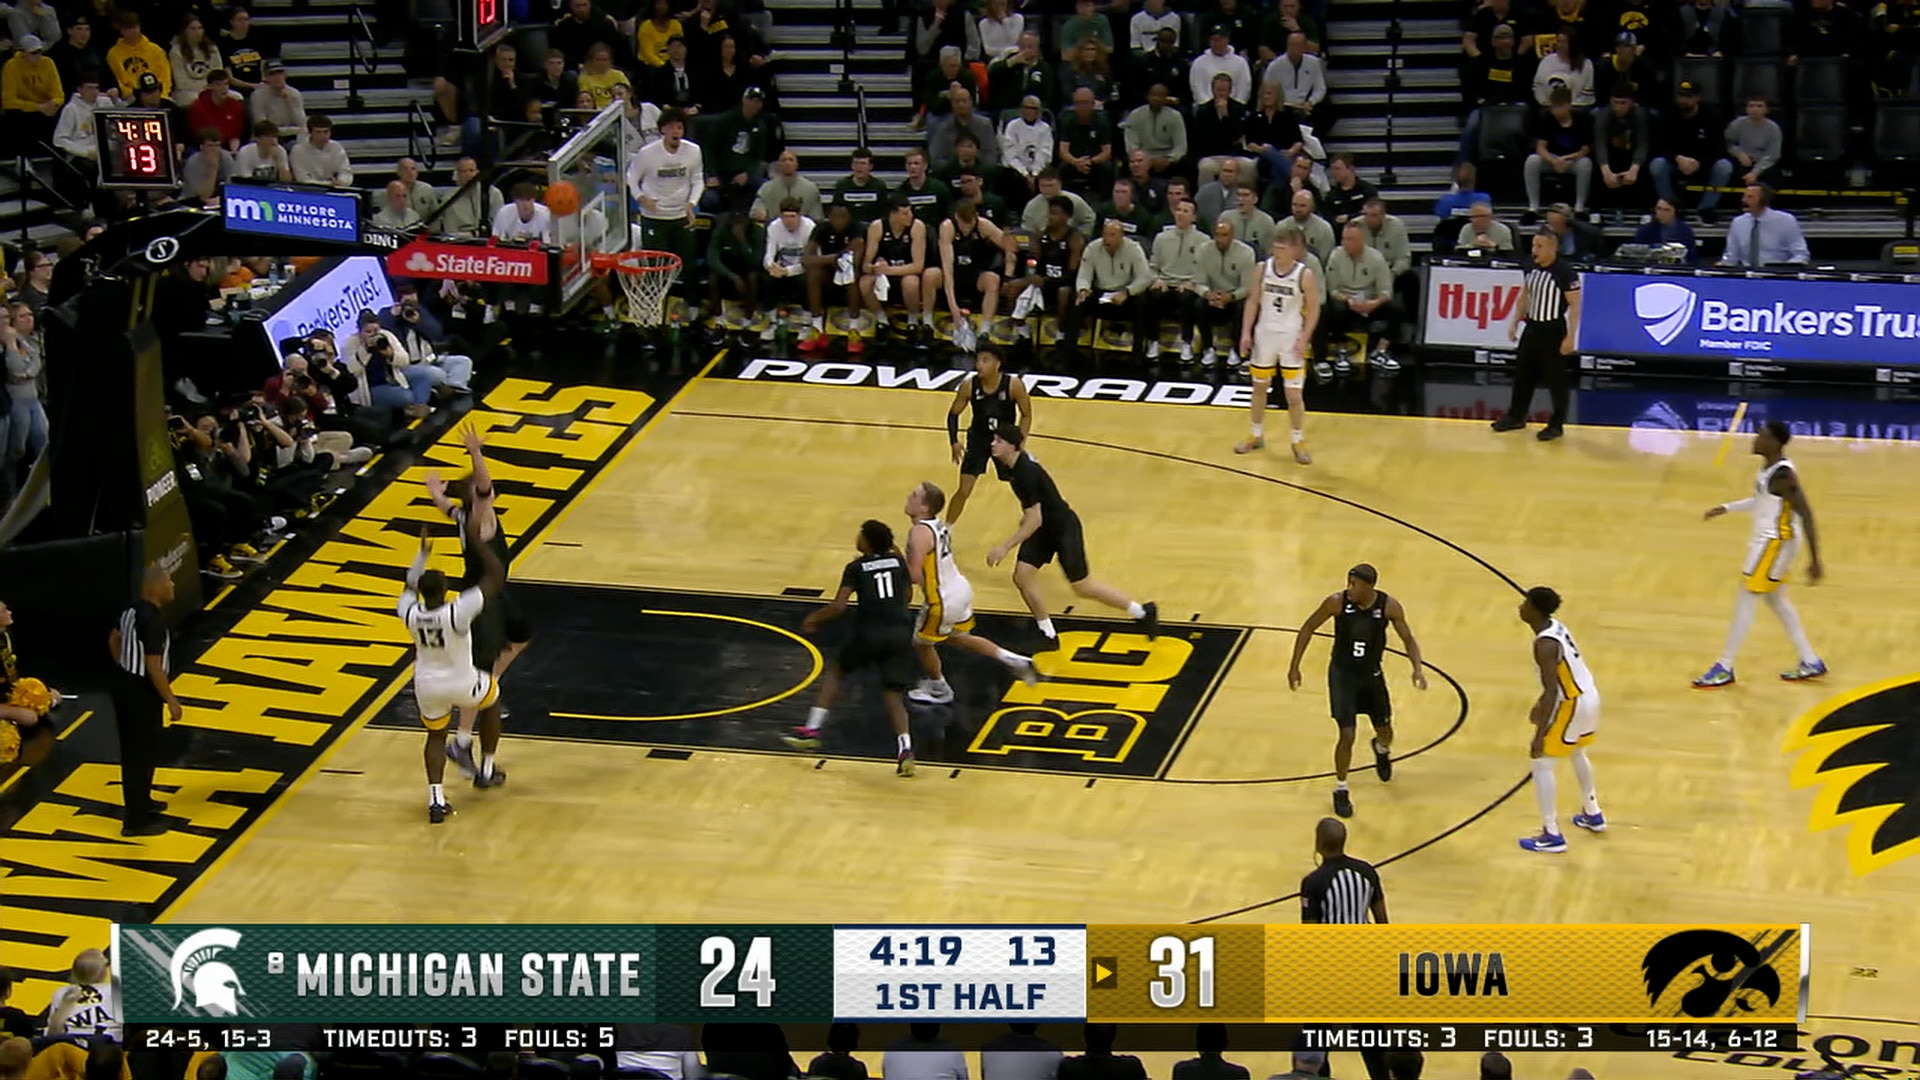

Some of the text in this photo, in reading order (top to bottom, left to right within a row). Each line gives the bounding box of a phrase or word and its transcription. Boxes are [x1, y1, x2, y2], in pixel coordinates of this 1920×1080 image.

[118, 121, 163, 141] 4:19
[129, 145, 157, 172] 13
[1045, 264, 1062, 278] 55
[1700, 338, 1772, 351] Member FDIC
[738, 358, 1273, 409] POWRADE
[873, 571, 894, 599] 11
[418, 628, 445, 648] 13
[1353, 641, 1366, 657] 5
